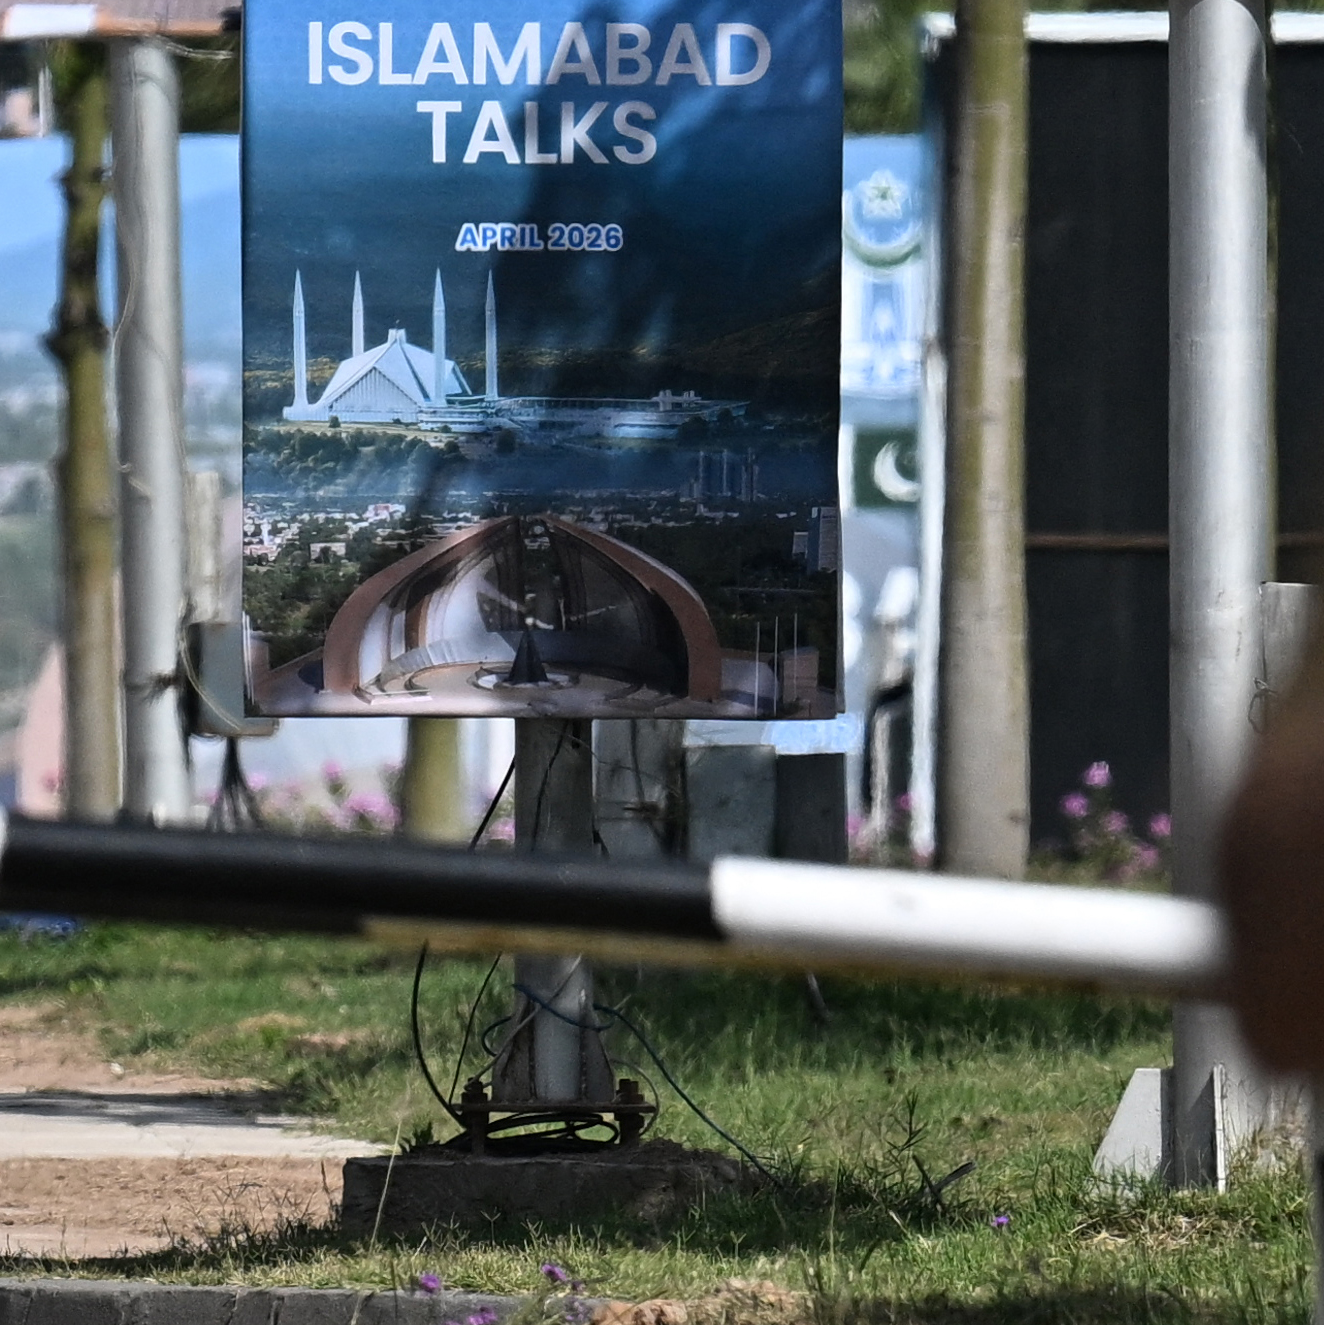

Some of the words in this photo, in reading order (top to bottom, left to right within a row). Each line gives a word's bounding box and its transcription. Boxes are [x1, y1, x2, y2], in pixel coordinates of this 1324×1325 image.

[308, 20, 772, 86] ISLAMABAD
[416, 100, 658, 164] TALKS
[455, 223, 545, 251] APRIL
[547, 223, 623, 251] 2026
